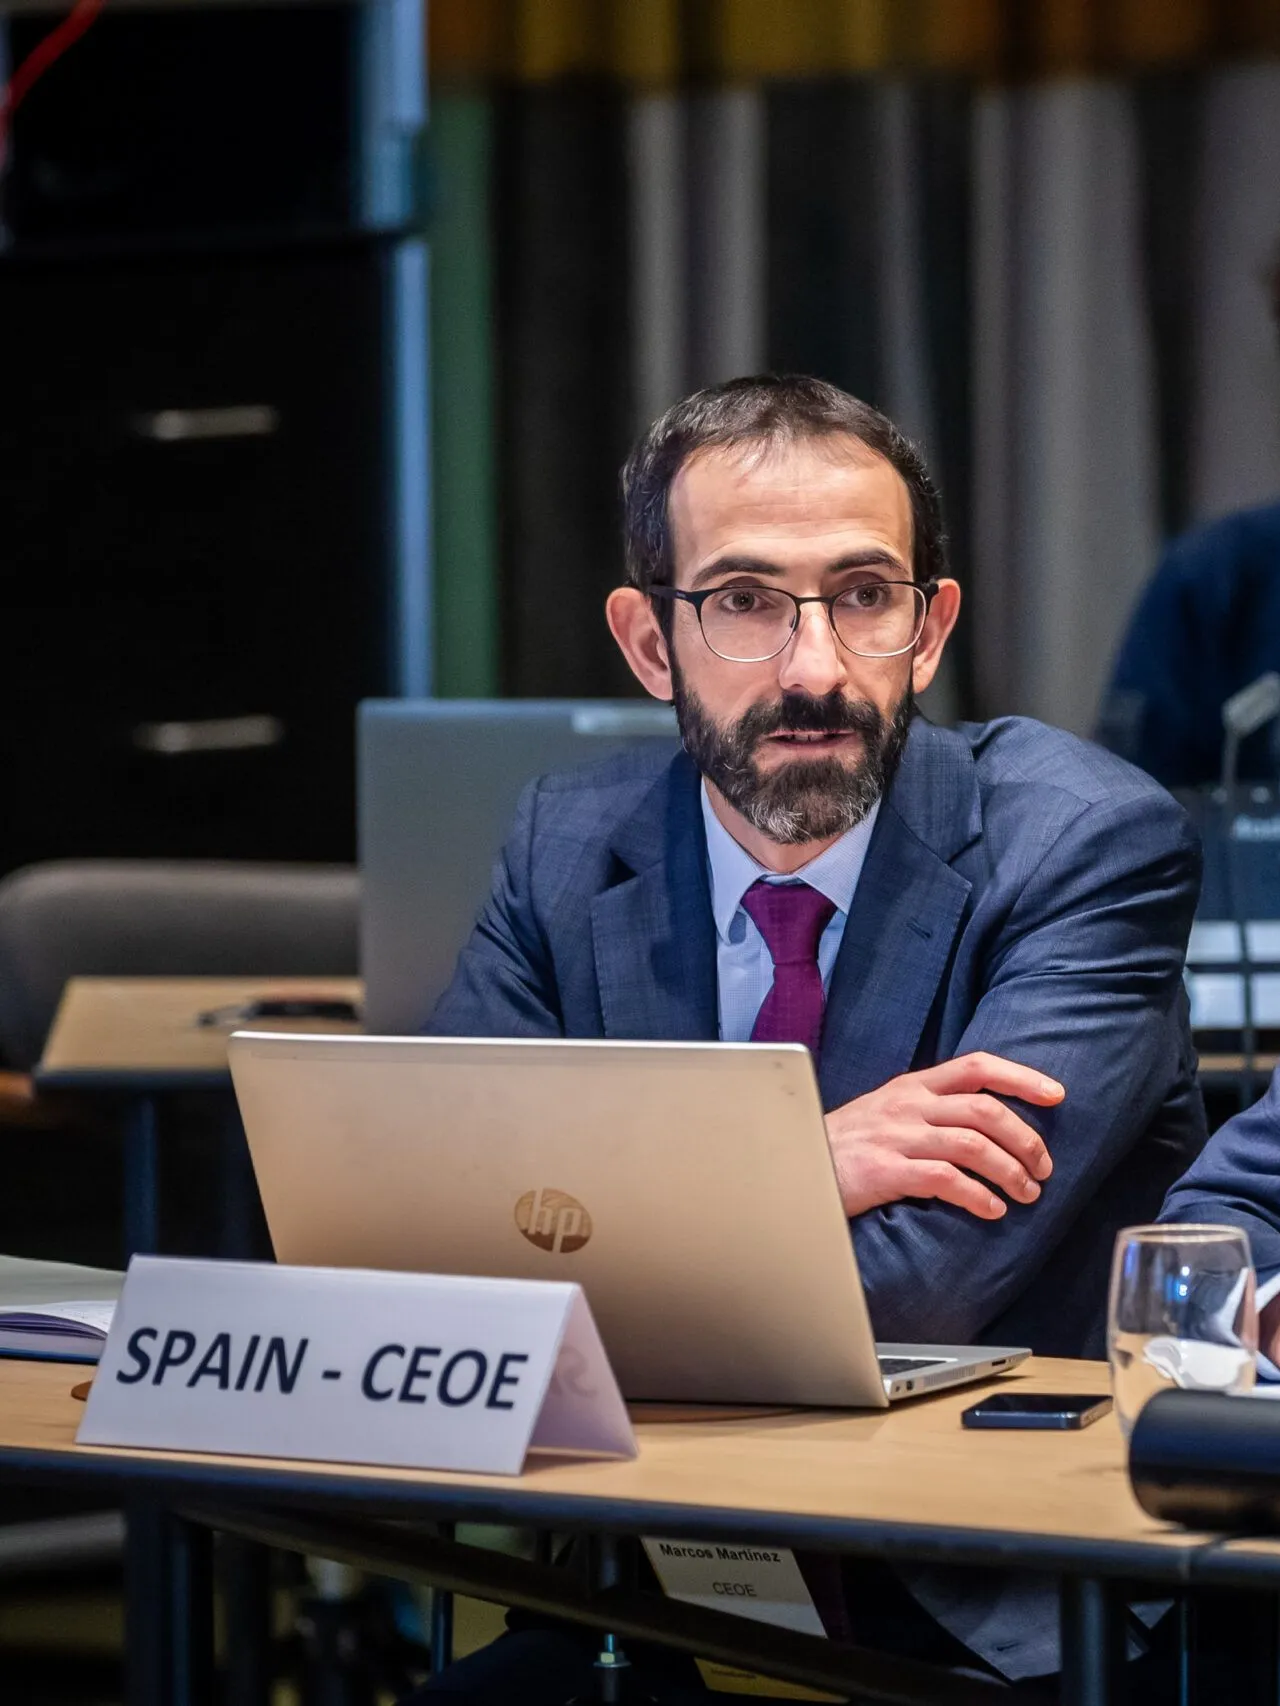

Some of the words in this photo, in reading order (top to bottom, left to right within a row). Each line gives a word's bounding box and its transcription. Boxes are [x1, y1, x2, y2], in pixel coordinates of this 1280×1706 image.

[527, 1186, 582, 1254] hp
[116, 1327, 308, 1394] SPAIN
[321, 1369, 341, 1381] -
[360, 1343, 529, 1410] CEOE
[660, 1543, 713, 1560] Marcos
[712, 1582, 757, 1597] CEOE
